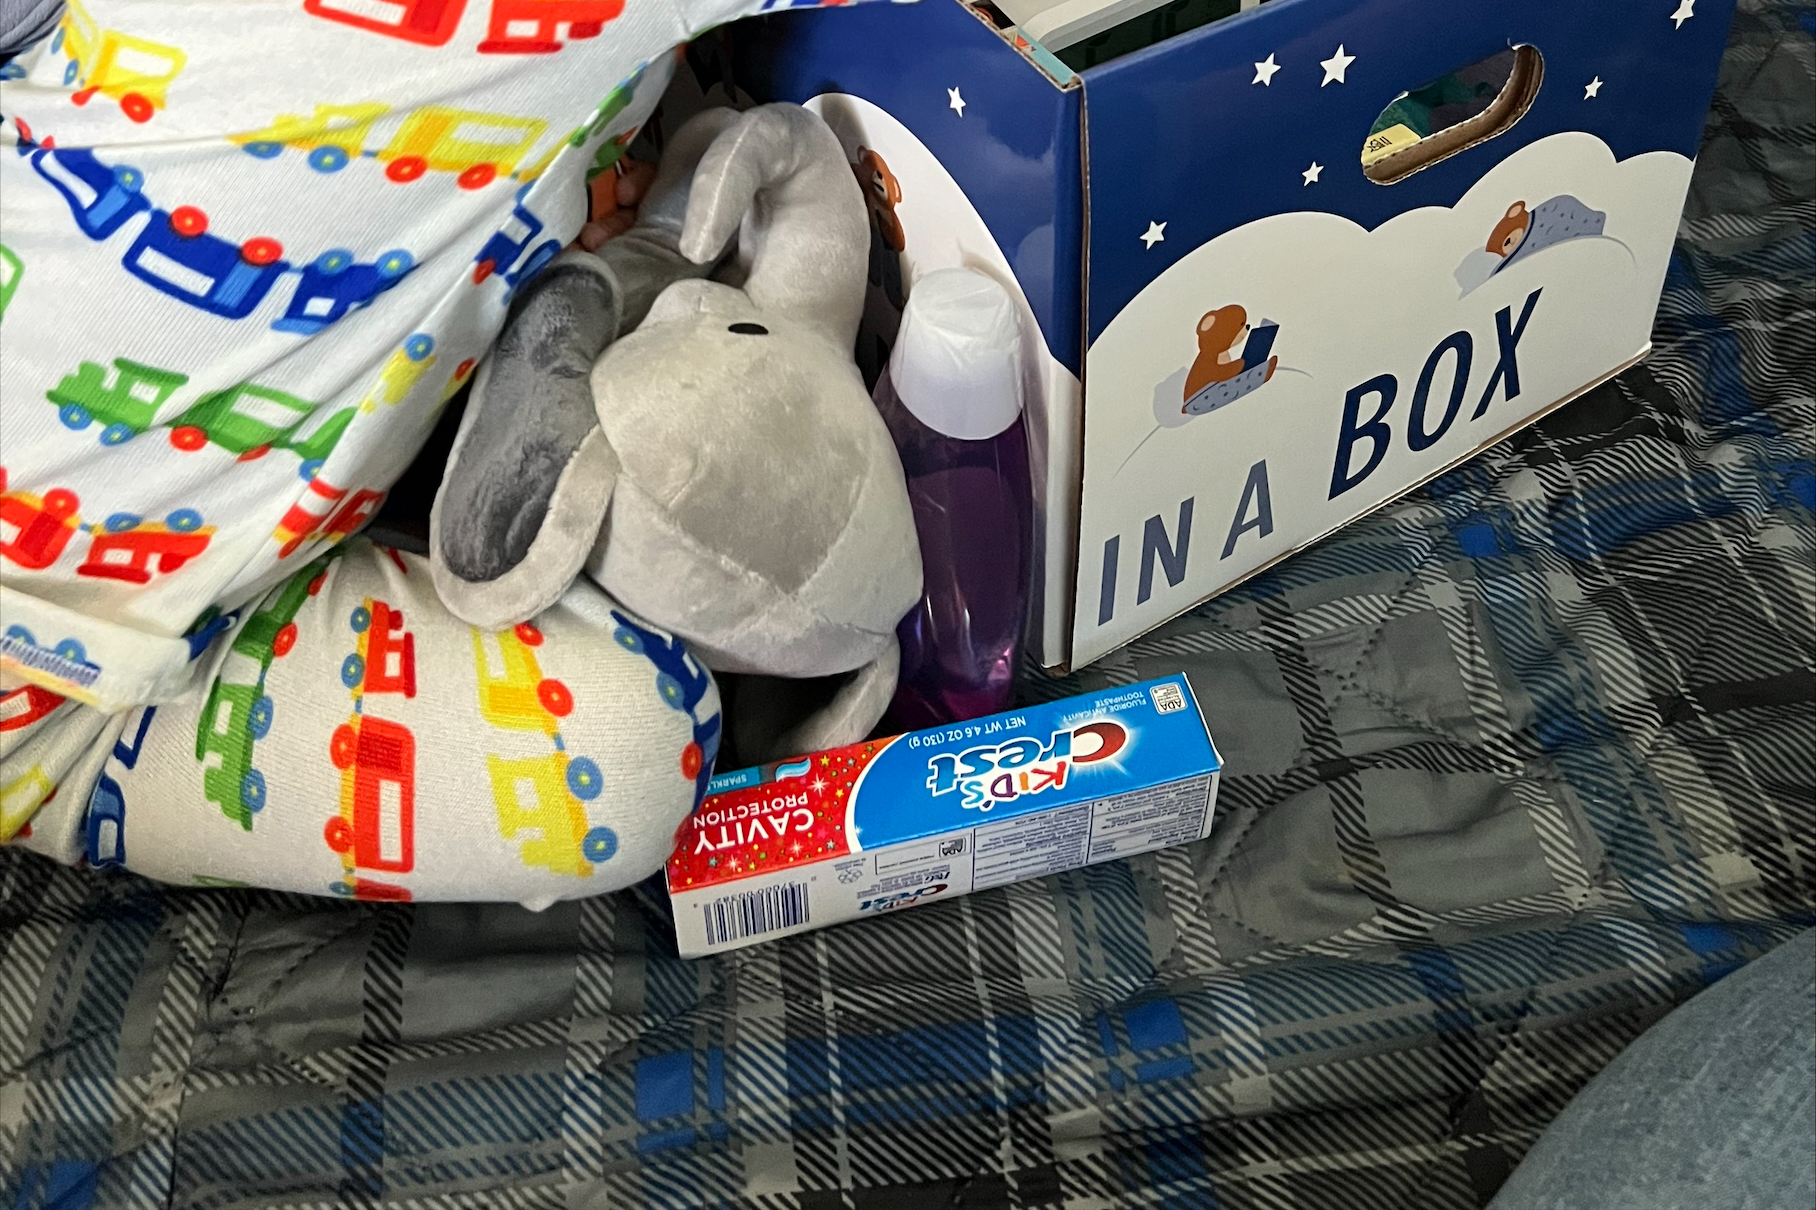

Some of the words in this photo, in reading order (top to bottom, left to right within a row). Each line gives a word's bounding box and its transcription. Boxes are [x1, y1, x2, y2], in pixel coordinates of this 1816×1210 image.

[1098, 496, 1195, 627] IN
[1219, 458, 1274, 561] A
[1328, 286, 1544, 502] BOX
[1094, 691, 1144, 708] TOOTHPASTE
[1109, 698, 1147, 712] FLUORIDE
[1160, 699, 1182, 711] ADA
[1062, 706, 1107, 723] ANTICAVITY
[985, 721, 1003, 734] WT
[1005, 716, 1026, 729] NET
[948, 728, 964, 742] OZ
[964, 725, 981, 738] 4.6
[908, 737, 921, 750] g)
[924, 732, 945, 748] (130
[929, 722, 1127, 792] Crest
[693, 792, 809, 829] PROTECTION
[694, 808, 814, 855] CAVITY
